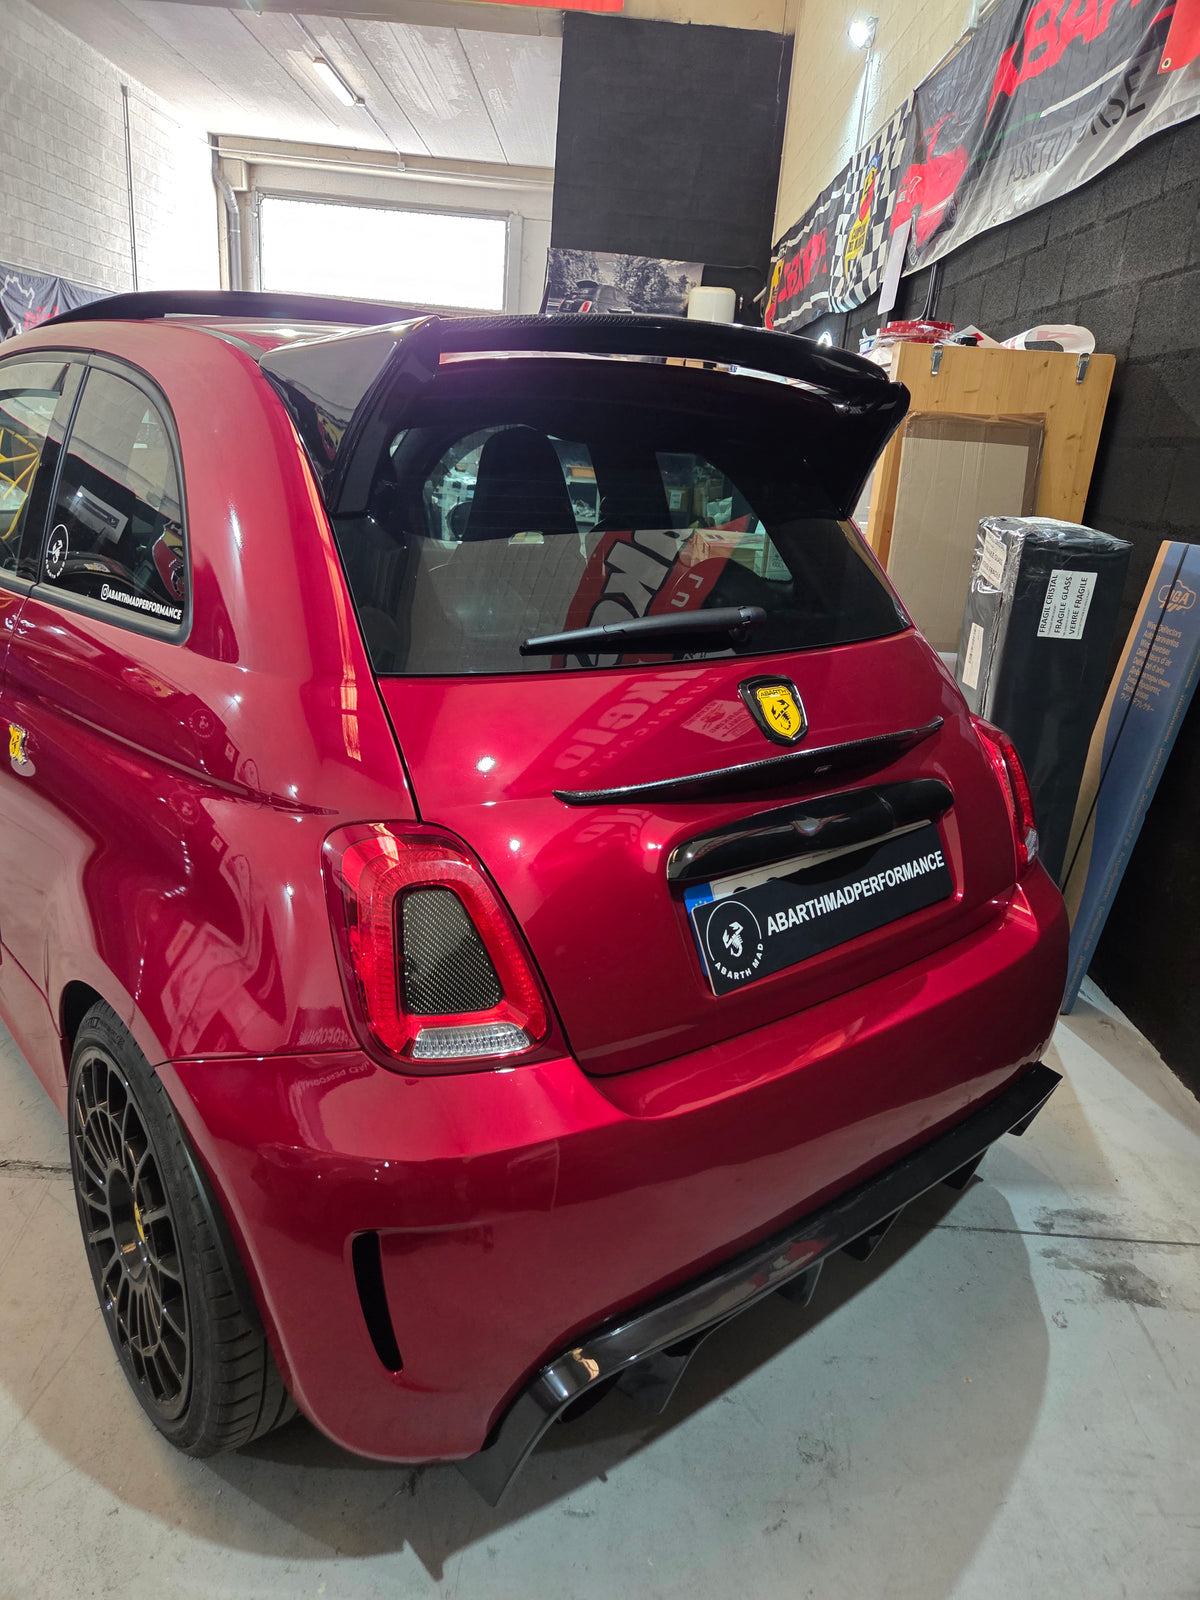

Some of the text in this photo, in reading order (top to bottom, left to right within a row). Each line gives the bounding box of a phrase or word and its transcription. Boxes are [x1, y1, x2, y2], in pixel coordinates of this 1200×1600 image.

[1039, 606, 1051, 633] FRAGIL
[1045, 574, 1059, 605] CRISTAL
[1054, 602, 1067, 634] FRAGILE
[1061, 576, 1073, 601] GLASS
[1068, 610, 1080, 635] VERRE
[1074, 577, 1088, 609] FRAGILE
[760, 689, 787, 697] ABARTH
[767, 850, 946, 936] ABARTHMADPERFORMANCE
[715, 943, 764, 980] ABARTH MAD
